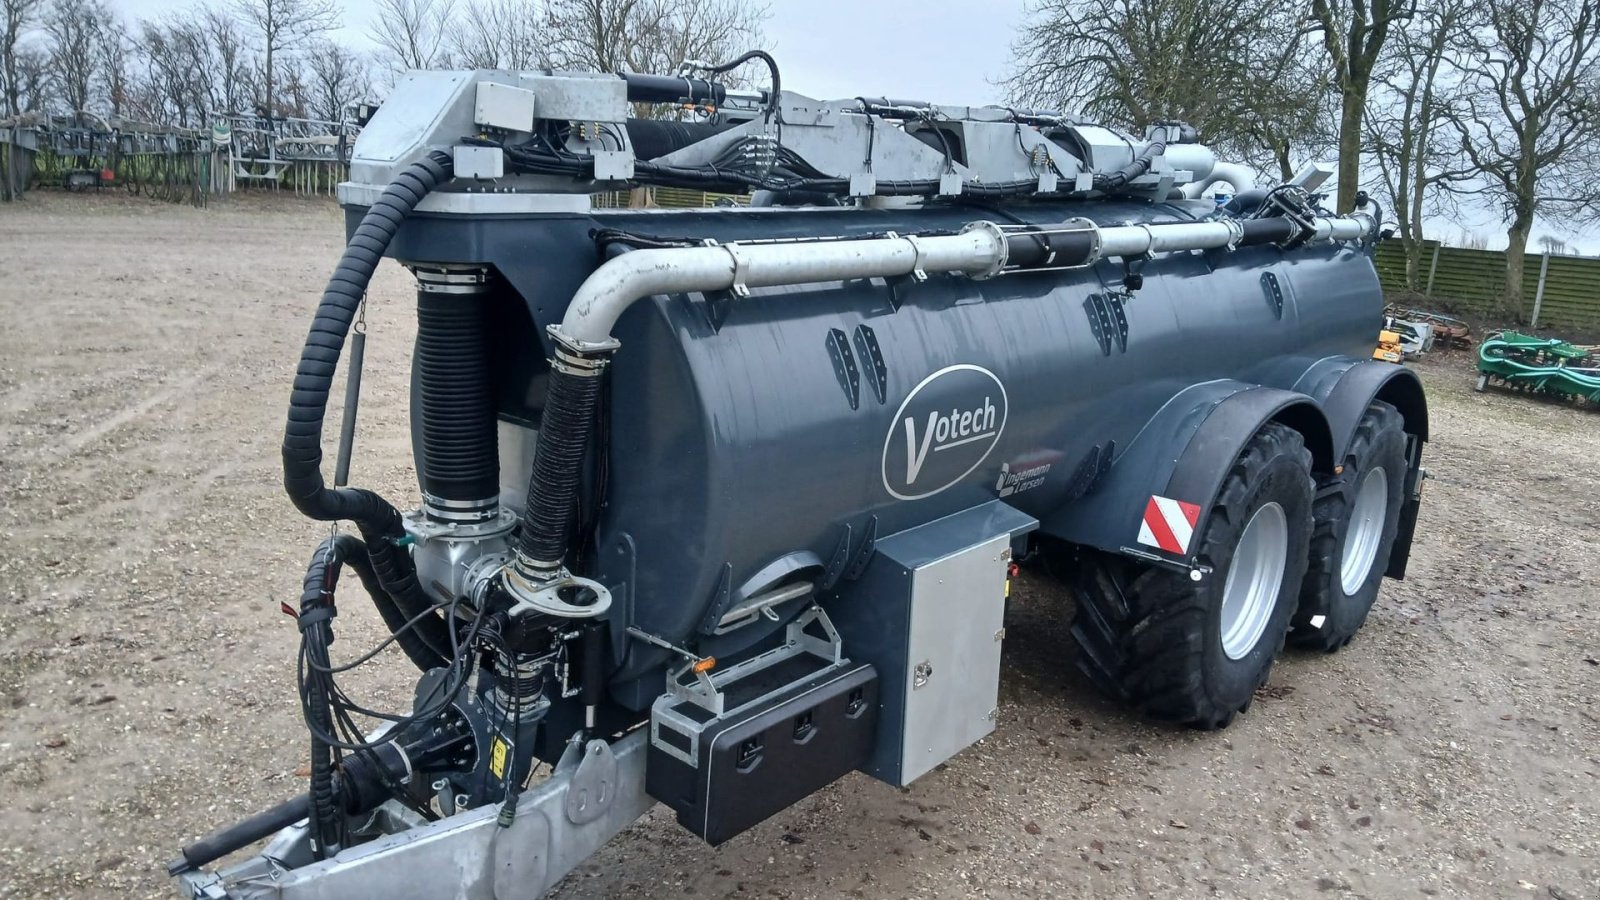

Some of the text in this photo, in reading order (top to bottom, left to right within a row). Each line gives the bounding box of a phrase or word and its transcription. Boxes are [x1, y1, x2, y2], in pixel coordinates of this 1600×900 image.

[904, 396, 996, 485] Votech
[1005, 463, 1051, 486] Ingemann
[1014, 476, 1045, 494] Larsen
